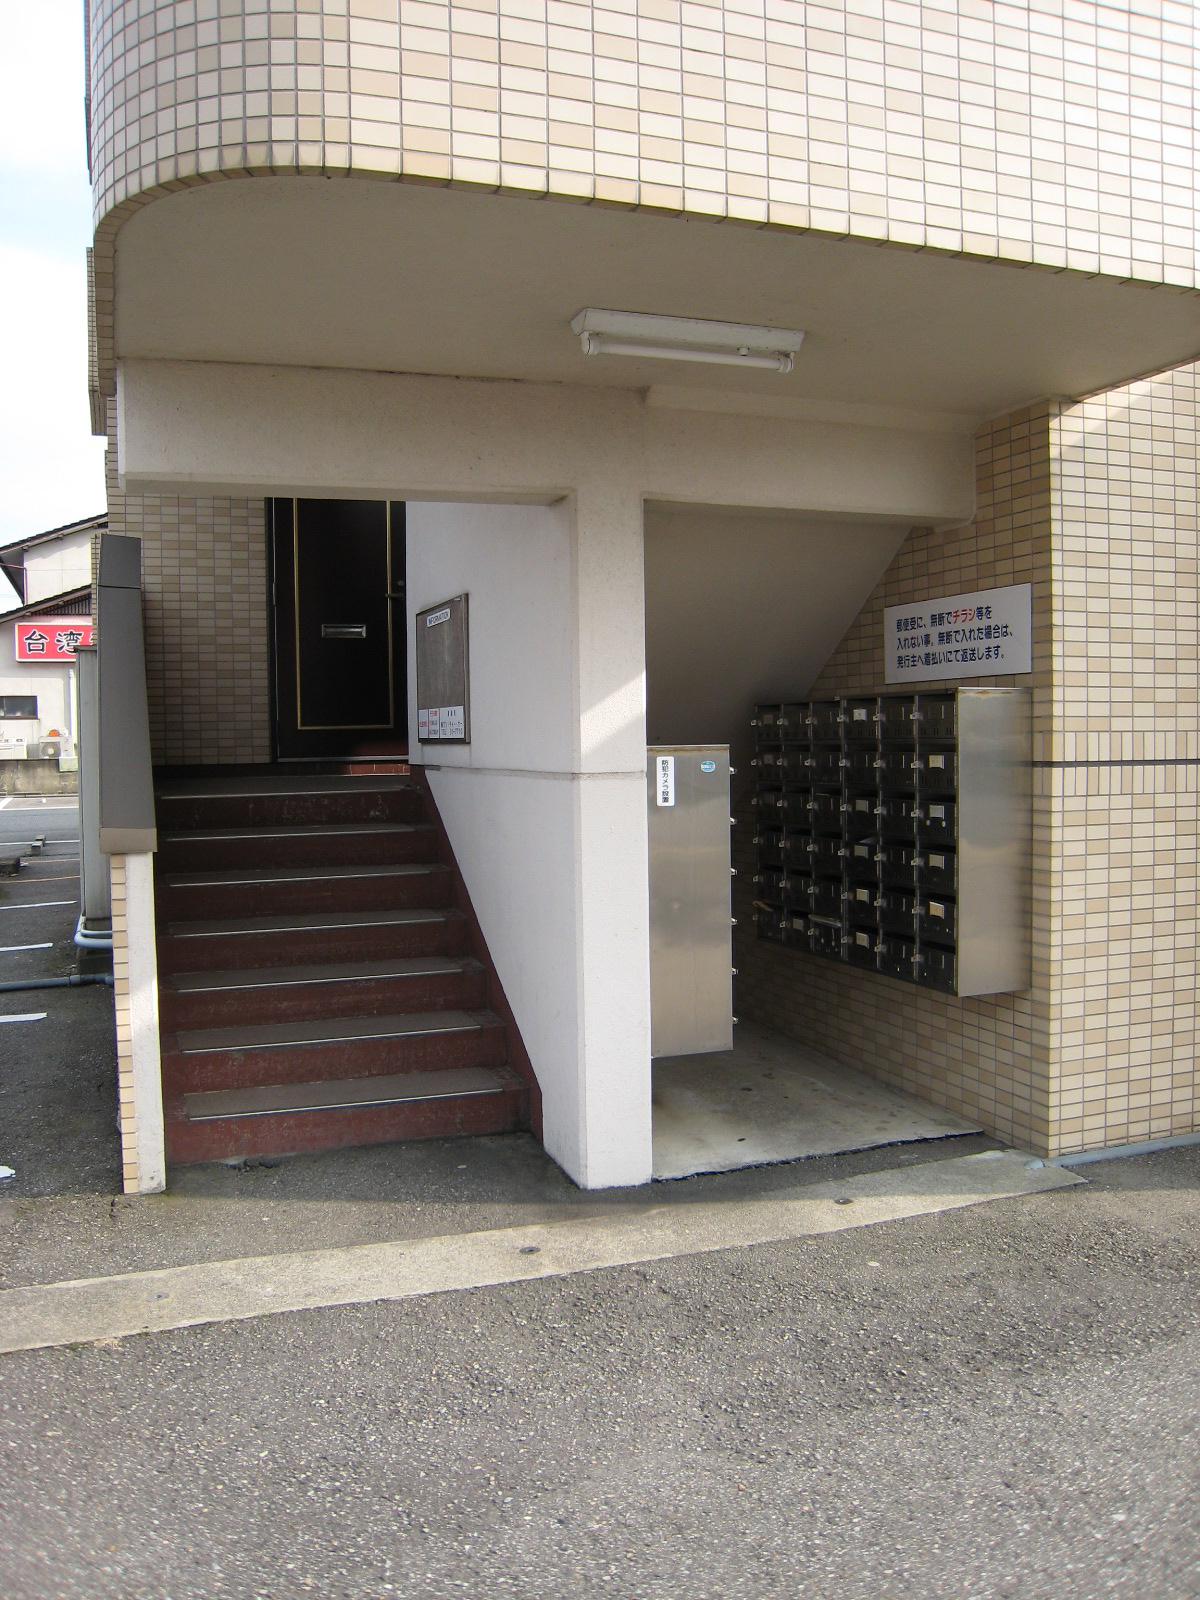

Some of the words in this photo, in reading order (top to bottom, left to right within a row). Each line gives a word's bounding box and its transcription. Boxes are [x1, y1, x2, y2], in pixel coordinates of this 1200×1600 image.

[25, 630, 97, 654] 台湾
[661, 759, 669, 803] 防犯カメラ設置
